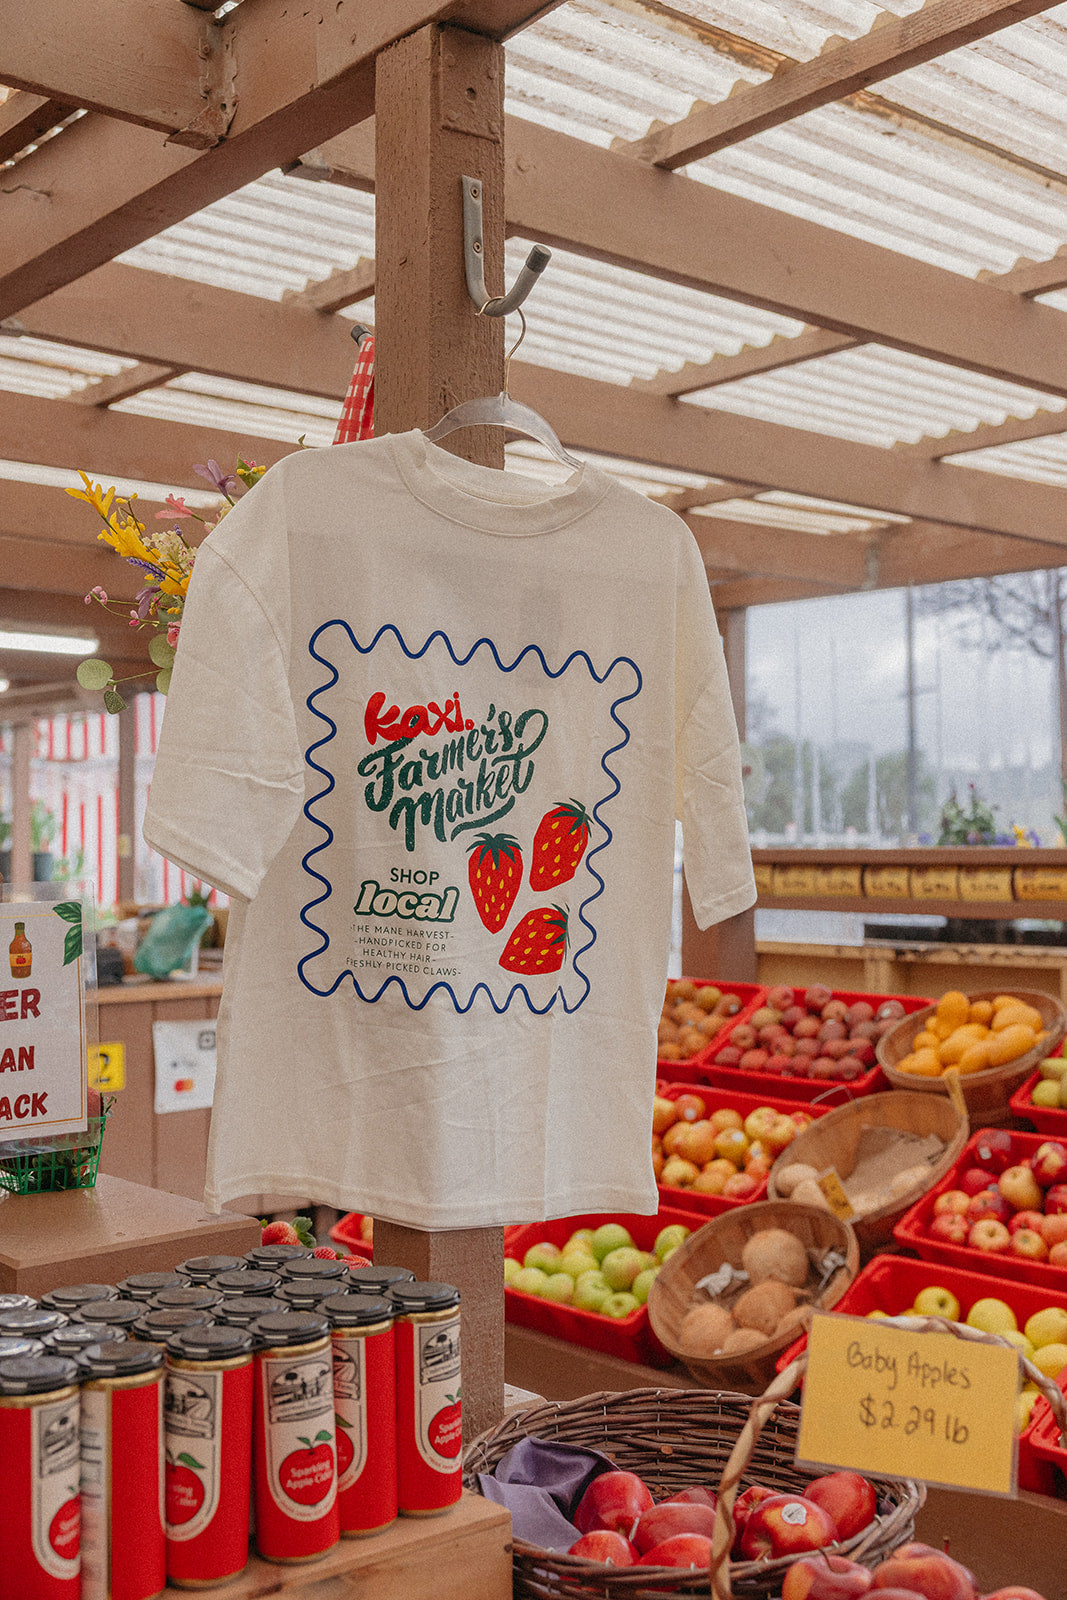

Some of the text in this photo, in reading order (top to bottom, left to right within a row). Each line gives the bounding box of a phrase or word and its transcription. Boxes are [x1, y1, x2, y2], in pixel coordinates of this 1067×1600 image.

[390, 867, 440, 885] SHOP
[353, 879, 460, 922] local
[374, 926, 403, 936] MANE
[362, 948, 407, 959] HEALTHY
[425, 942, 446, 952] FOR
[386, 961, 420, 974] PICKED
[907, 1351, 972, 1389] Apples
